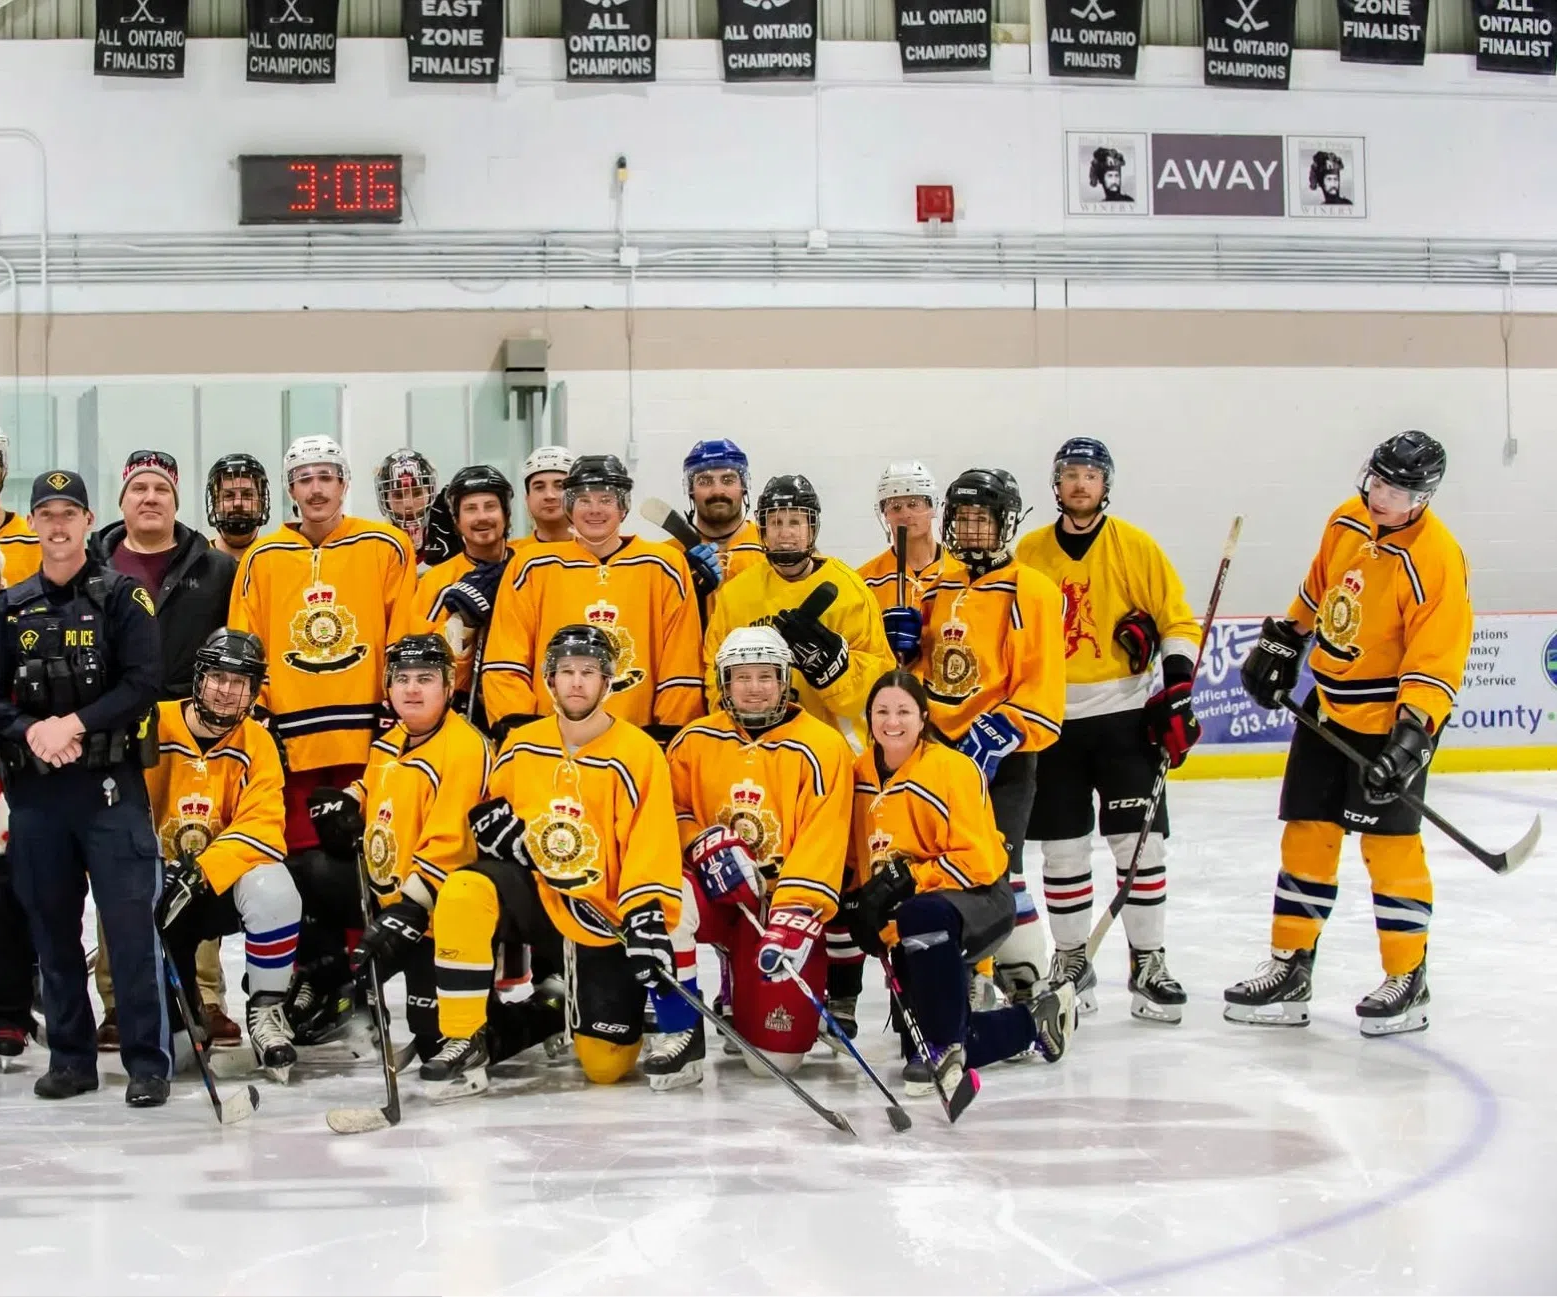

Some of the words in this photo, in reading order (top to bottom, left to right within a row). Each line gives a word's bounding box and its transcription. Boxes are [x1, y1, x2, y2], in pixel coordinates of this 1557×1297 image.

[421, 0, 483, 17] EAST
[1354, 0, 1411, 16] ZONE
[1497, 0, 1535, 12] ALL
[587, 12, 630, 30] ALL
[901, 9, 925, 27] ALL
[929, 8, 987, 26] ONTARIO
[1479, 15, 1553, 36] ONTARIO
[97, 29, 121, 47] ALL
[128, 29, 184, 48] ONTARIO
[421, 29, 484, 47] ZONE
[724, 25, 748, 42] ALL
[752, 23, 813, 41] ONTARIO
[1050, 28, 1075, 45] ALL
[1080, 28, 1136, 47] ONTARIO
[1343, 21, 1420, 42] FINALIST
[249, 32, 272, 49] ALL
[278, 32, 335, 51] ONTARIO
[569, 35, 652, 53] ONTARIO
[1206, 37, 1229, 54] ALL
[1233, 39, 1289, 58] ONTARIO
[1479, 37, 1553, 58] FINALIST
[103, 52, 176, 71] FINALISTS
[728, 52, 812, 70] CHAMPIONS
[904, 43, 988, 62] CHAMPIONS
[1063, 51, 1122, 70] FINALISTS
[249, 56, 331, 75] CHAMPIONS
[411, 56, 495, 75] FINALIST
[569, 57, 652, 76] CHAMPIONS
[1208, 60, 1286, 80] CHAMPIONS
[1157, 159, 1279, 190] AWAY
[289, 163, 396, 210] 3:06
[65, 630, 94, 646] POICE
[1260, 640, 1296, 659] CCM
[1475, 675, 1517, 686] Service
[1193, 689, 1229, 705] office
[1108, 798, 1151, 811] CCM
[1343, 809, 1380, 826] CCM
[692, 829, 741, 862] BAU
[631, 910, 664, 928] CC
[770, 910, 824, 936] BAU
[382, 915, 424, 943] CC
[596, 1021, 629, 1034] CCM
